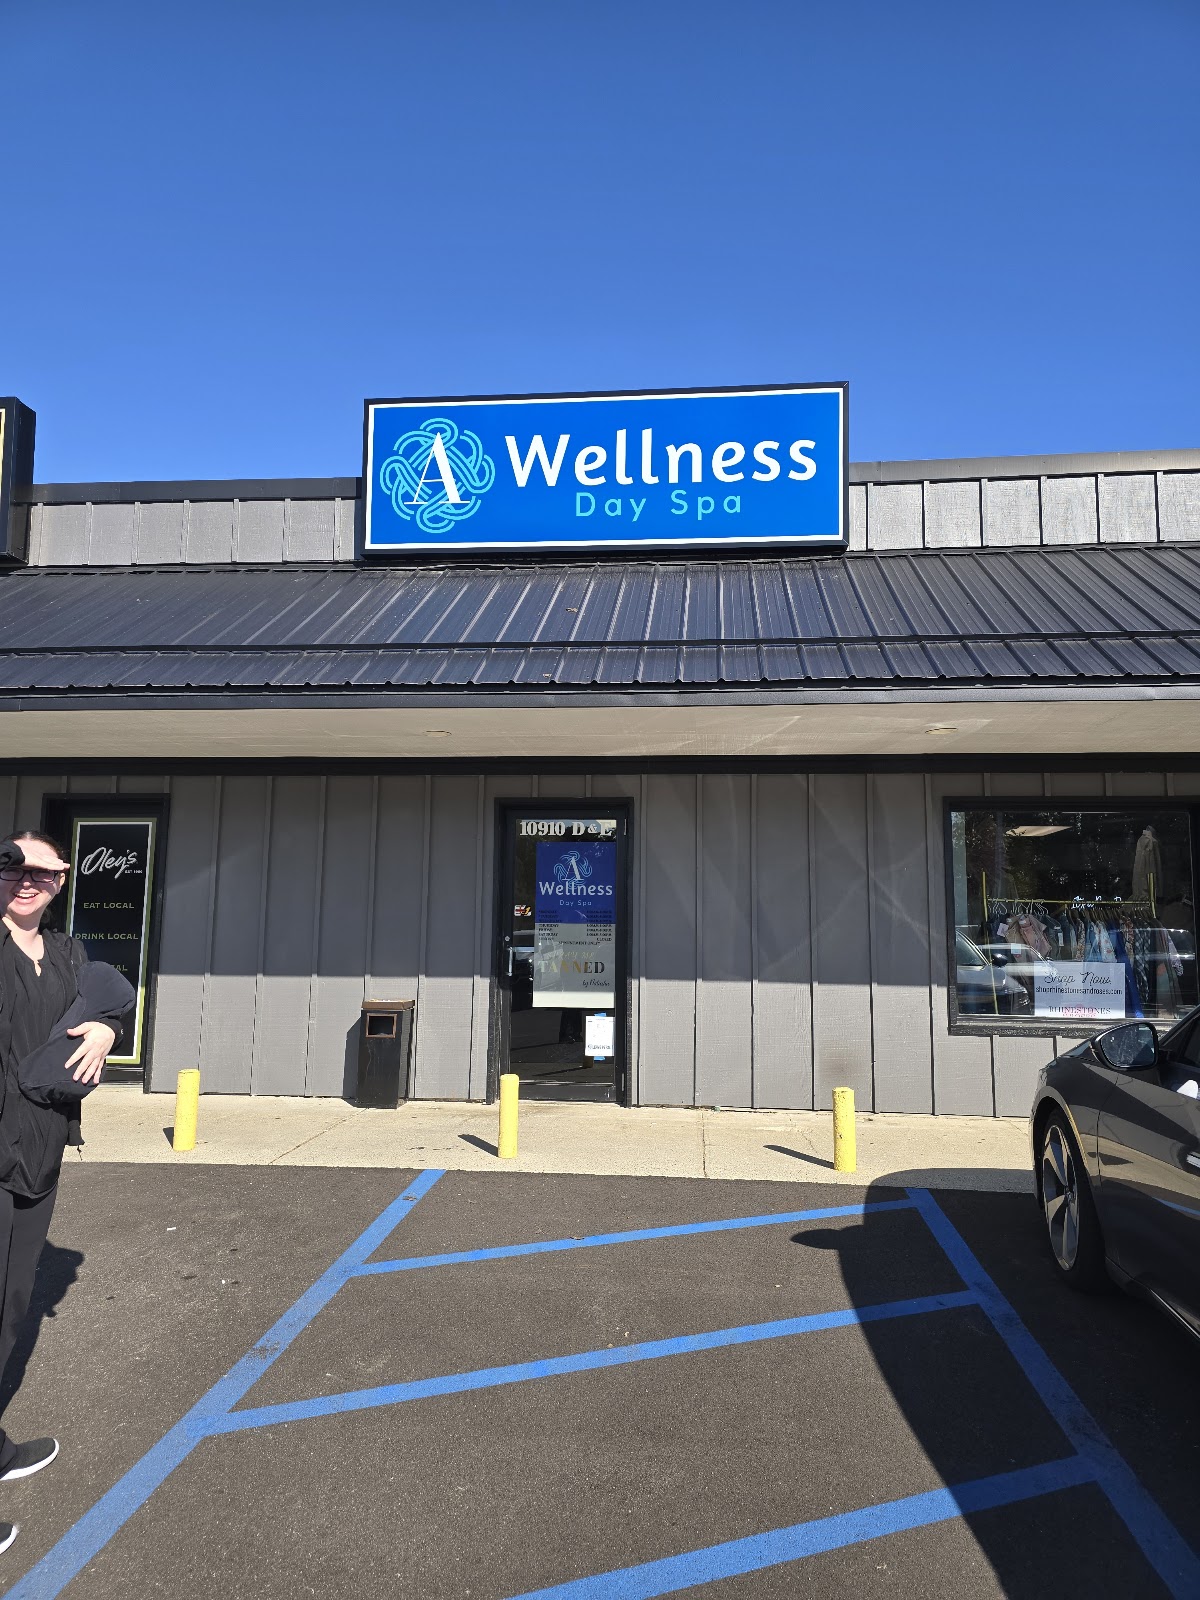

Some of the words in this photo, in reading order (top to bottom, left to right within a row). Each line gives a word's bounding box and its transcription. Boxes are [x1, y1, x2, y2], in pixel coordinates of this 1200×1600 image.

[404, 432, 471, 504] A
[505, 428, 817, 488] Wellness
[576, 492, 647, 522] Day
[671, 490, 742, 521] Spa
[520, 821, 566, 836] 10910
[571, 821, 586, 836] D
[588, 824, 598, 834] &
[600, 821, 613, 836] E
[81, 847, 138, 879] Oley's
[539, 881, 613, 896] Wellness
[538, 960, 605, 974] TANNED
[1048, 1005, 1111, 1016] RHINESTONES
